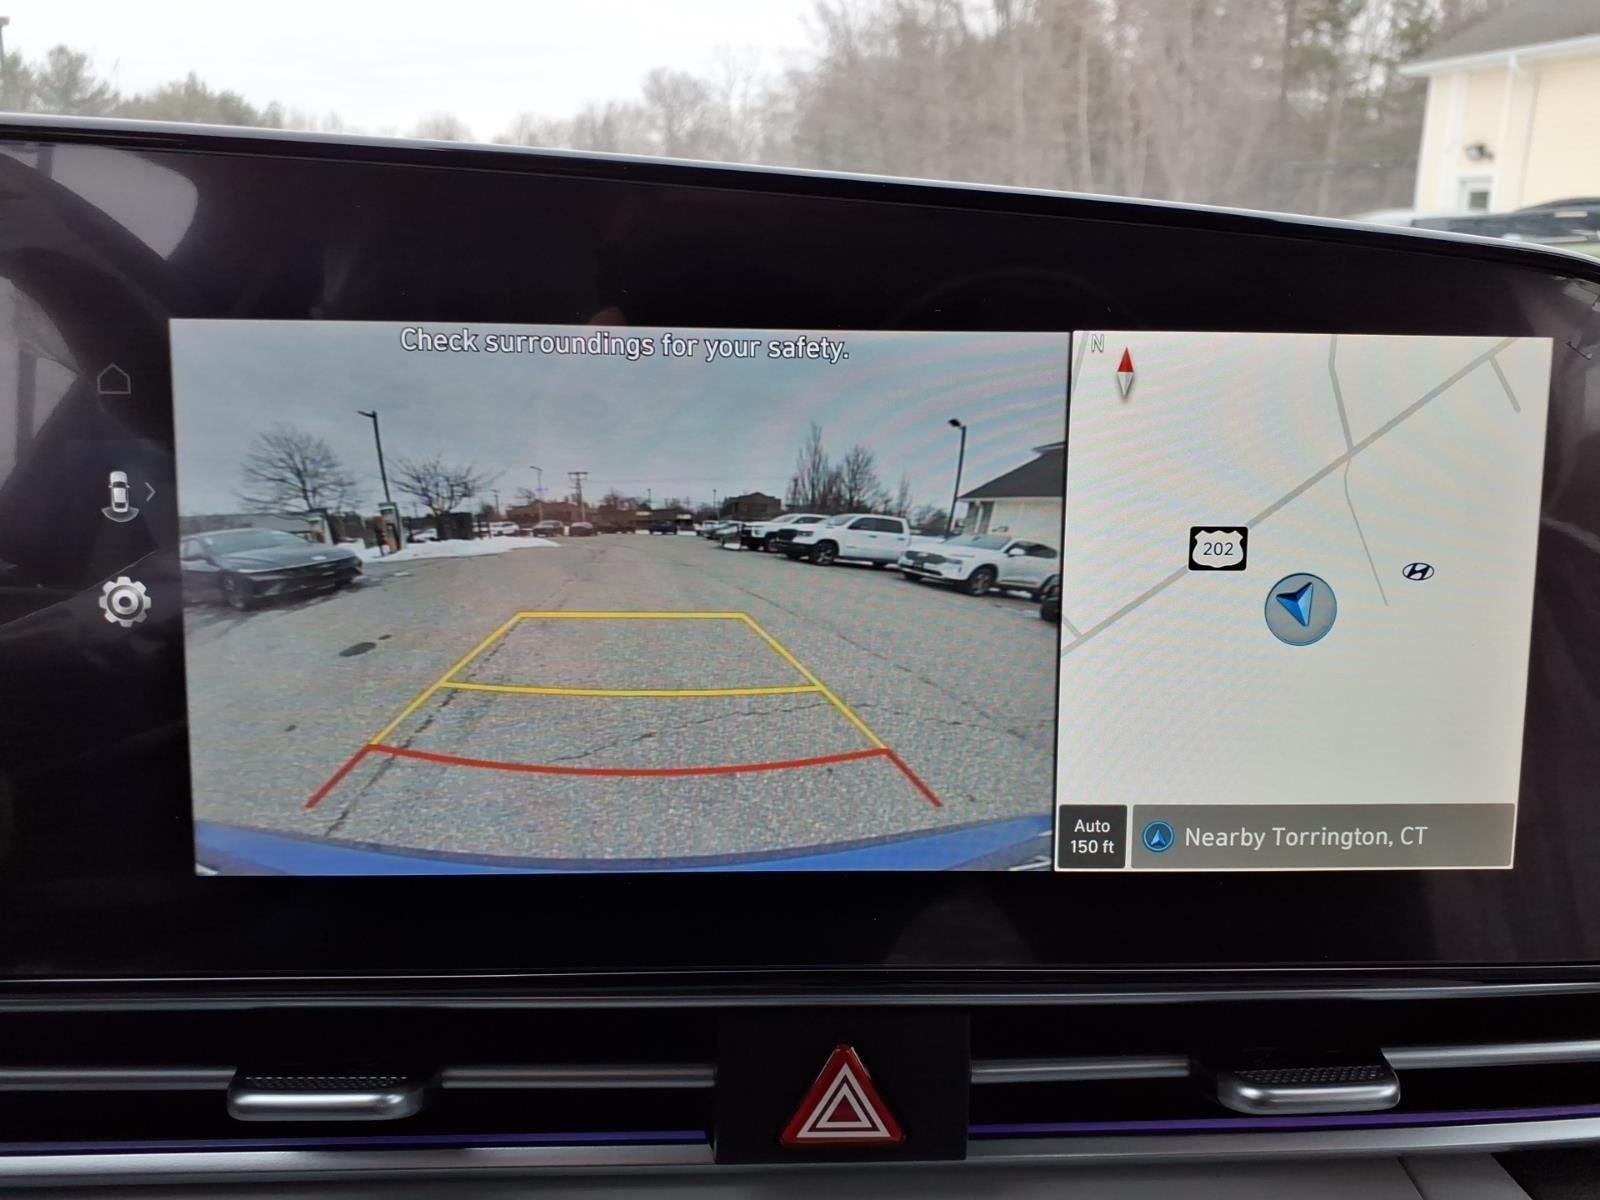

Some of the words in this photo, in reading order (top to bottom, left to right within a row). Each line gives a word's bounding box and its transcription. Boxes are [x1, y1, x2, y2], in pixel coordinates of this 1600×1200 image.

[400, 327, 479, 353] Check
[485, 330, 655, 361] surroundings
[661, 333, 699, 357] for
[704, 339, 761, 362] your
[767, 335, 850, 364] safety.
[1090, 334, 1105, 353] N
[1203, 541, 1234, 557] 202
[1074, 818, 1111, 834] Auto
[1070, 840, 1099, 855] 150
[1102, 839, 1115, 854] ft
[1185, 827, 1265, 852] Nearby
[1272, 825, 1394, 850] Torrington,
[1400, 826, 1428, 846] CT
